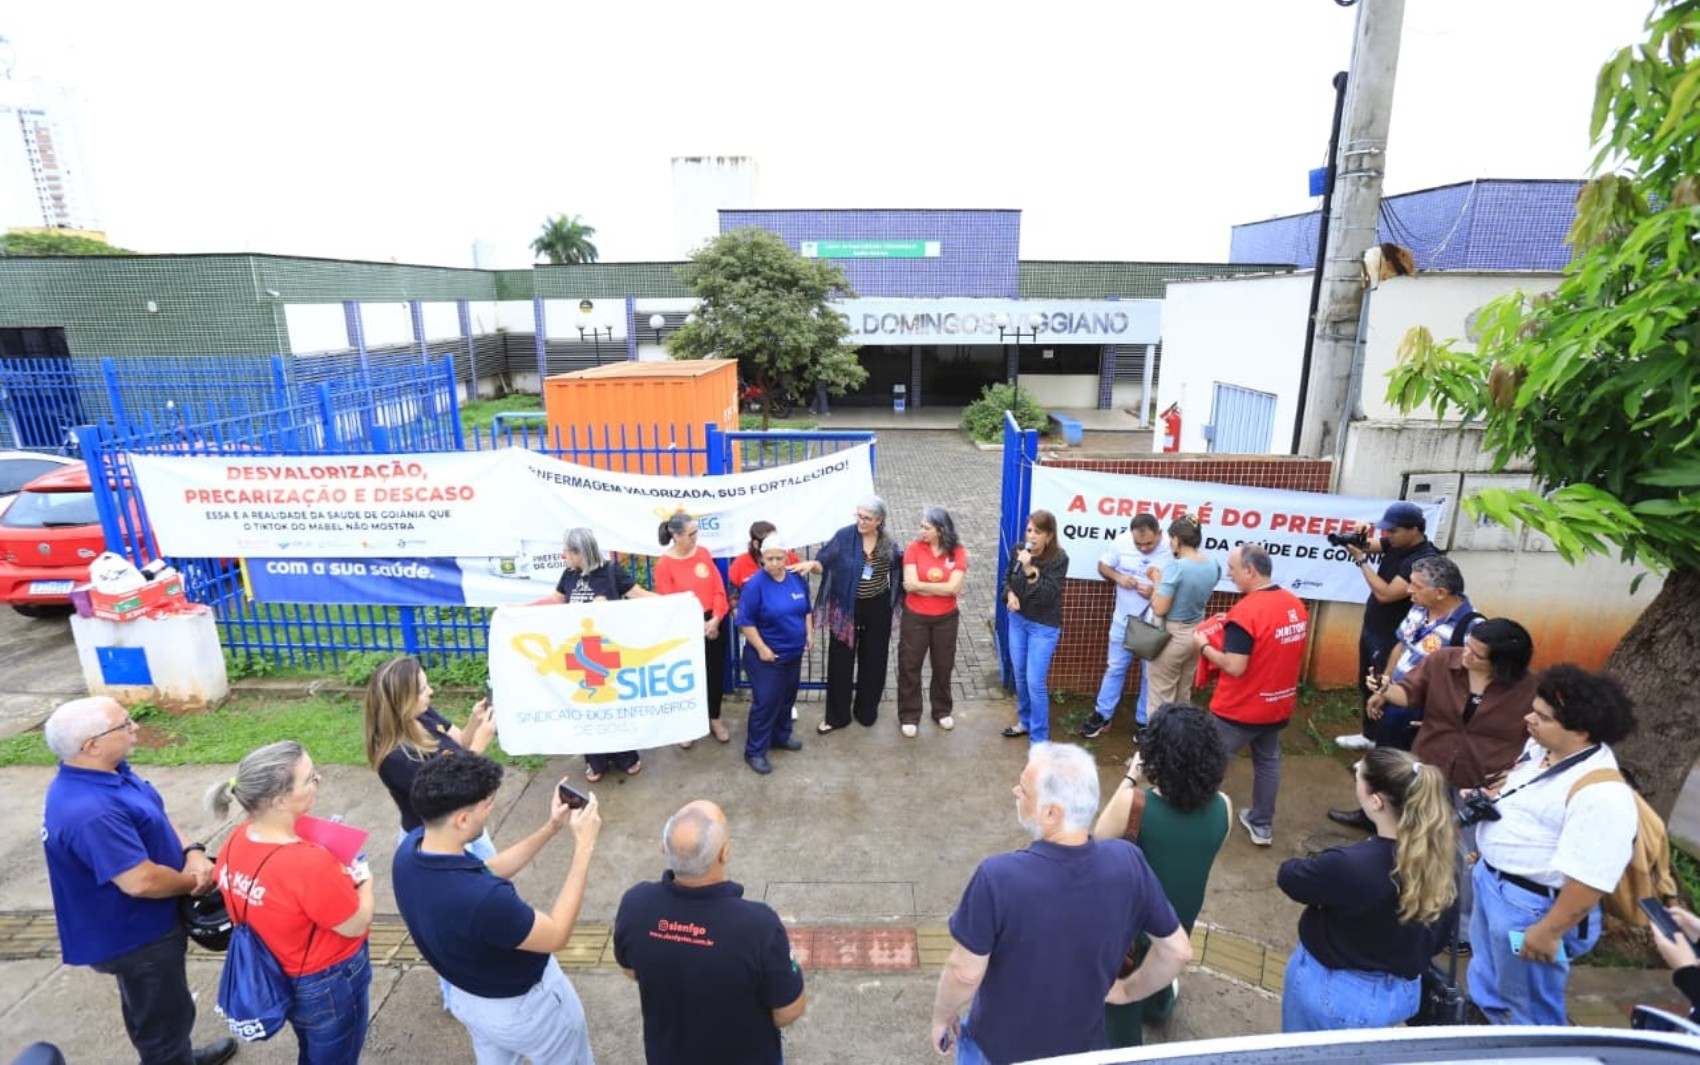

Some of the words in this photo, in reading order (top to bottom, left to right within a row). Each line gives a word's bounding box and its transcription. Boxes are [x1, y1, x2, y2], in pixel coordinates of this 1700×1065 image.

[862, 312, 995, 335] DOMINGOS
[226, 460, 428, 482] DESVALORIZAÇÃO,
[623, 484, 715, 499] VALORIZADA,
[718, 486, 746, 498] SUS
[750, 459, 850, 495] FORTALECIDO!
[184, 485, 348, 508] PRECARIZAÇÃO
[354, 488, 366, 503] E
[373, 485, 475, 503] DESCASO
[205, 511, 231, 520] ESSA
[242, 511, 249, 520] A
[251, 511, 308, 520] REALIDADE
[310, 511, 325, 520] DA
[364, 511, 378, 519] DE
[428, 510, 451, 520] QUE
[1067, 494, 1088, 513] A
[1097, 496, 1188, 521] GREVE
[1197, 502, 1213, 524] É
[1221, 507, 1262, 529] DO
[243, 523, 251, 531] O
[253, 523, 287, 531] TIKTOK
[290, 523, 306, 531] DO
[308, 523, 343, 531] MABEL
[371, 522, 415, 531] MOSTRA
[1063, 524, 1100, 540] QUE
[1205, 537, 1229, 550] DA
[1295, 546, 1318, 559] DE
[266, 560, 308, 576] com
[313, 563, 325, 576] a
[329, 563, 367, 576] sua
[370, 561, 436, 579] saúde.
[615, 659, 695, 701] SIEG
[516, 707, 582, 724] SINDICATO
[586, 707, 613, 721] DOS
[617, 698, 698, 719] ENFERMEIROS
